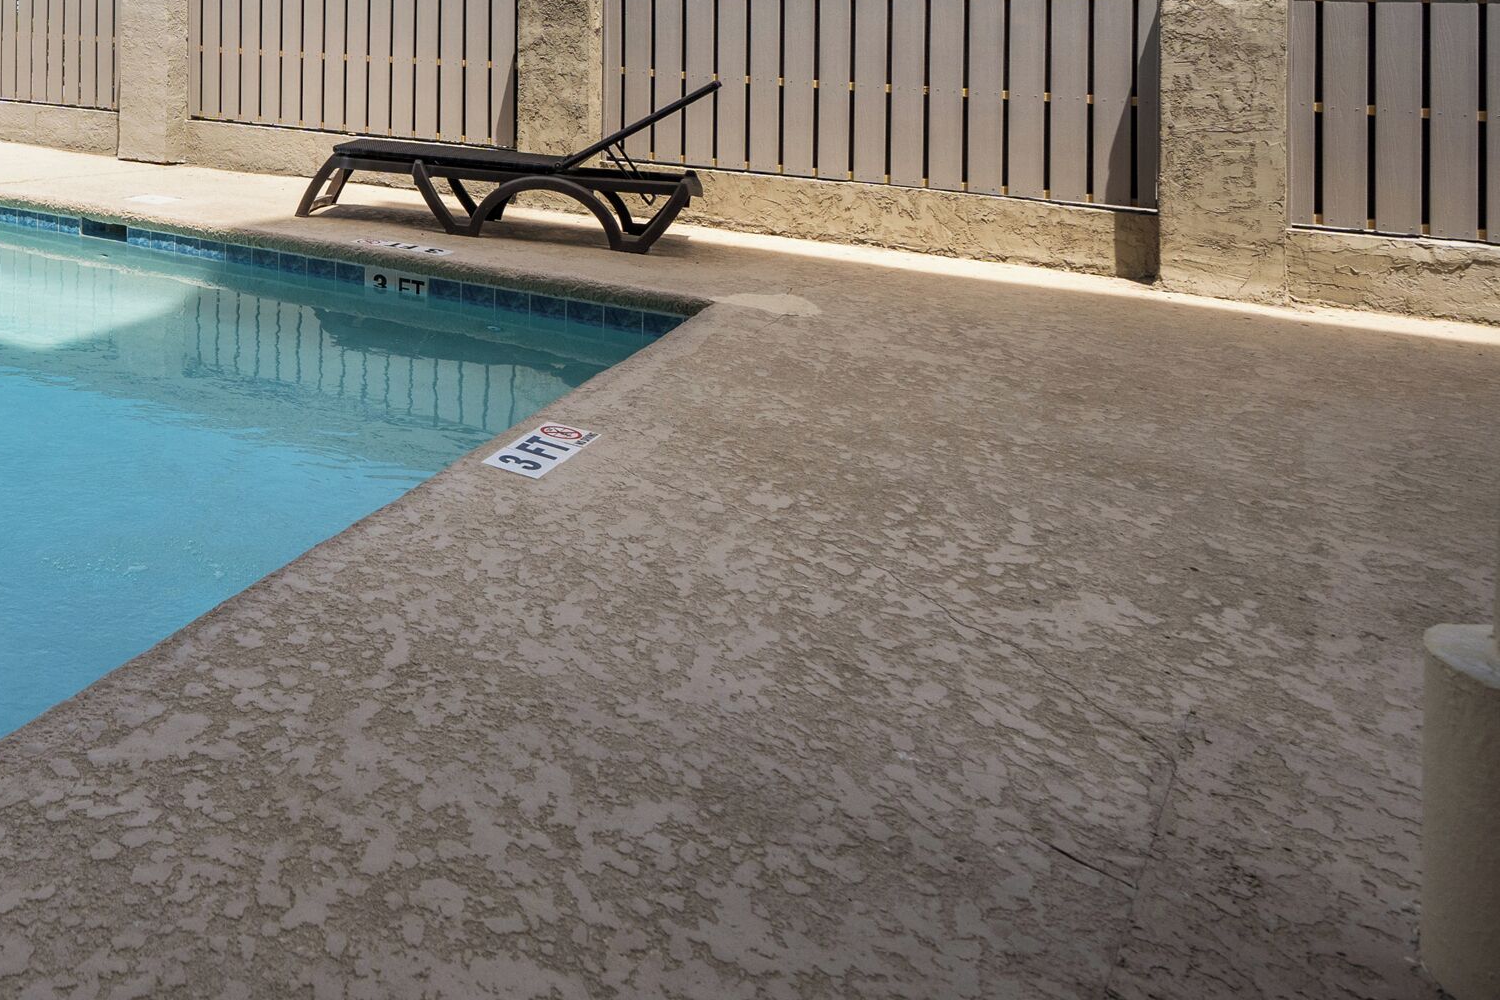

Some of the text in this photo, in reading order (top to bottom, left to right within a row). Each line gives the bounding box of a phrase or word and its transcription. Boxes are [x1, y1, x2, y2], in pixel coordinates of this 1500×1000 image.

[373, 274, 425, 295] 3 FT
[498, 435, 570, 471] 3 FT
